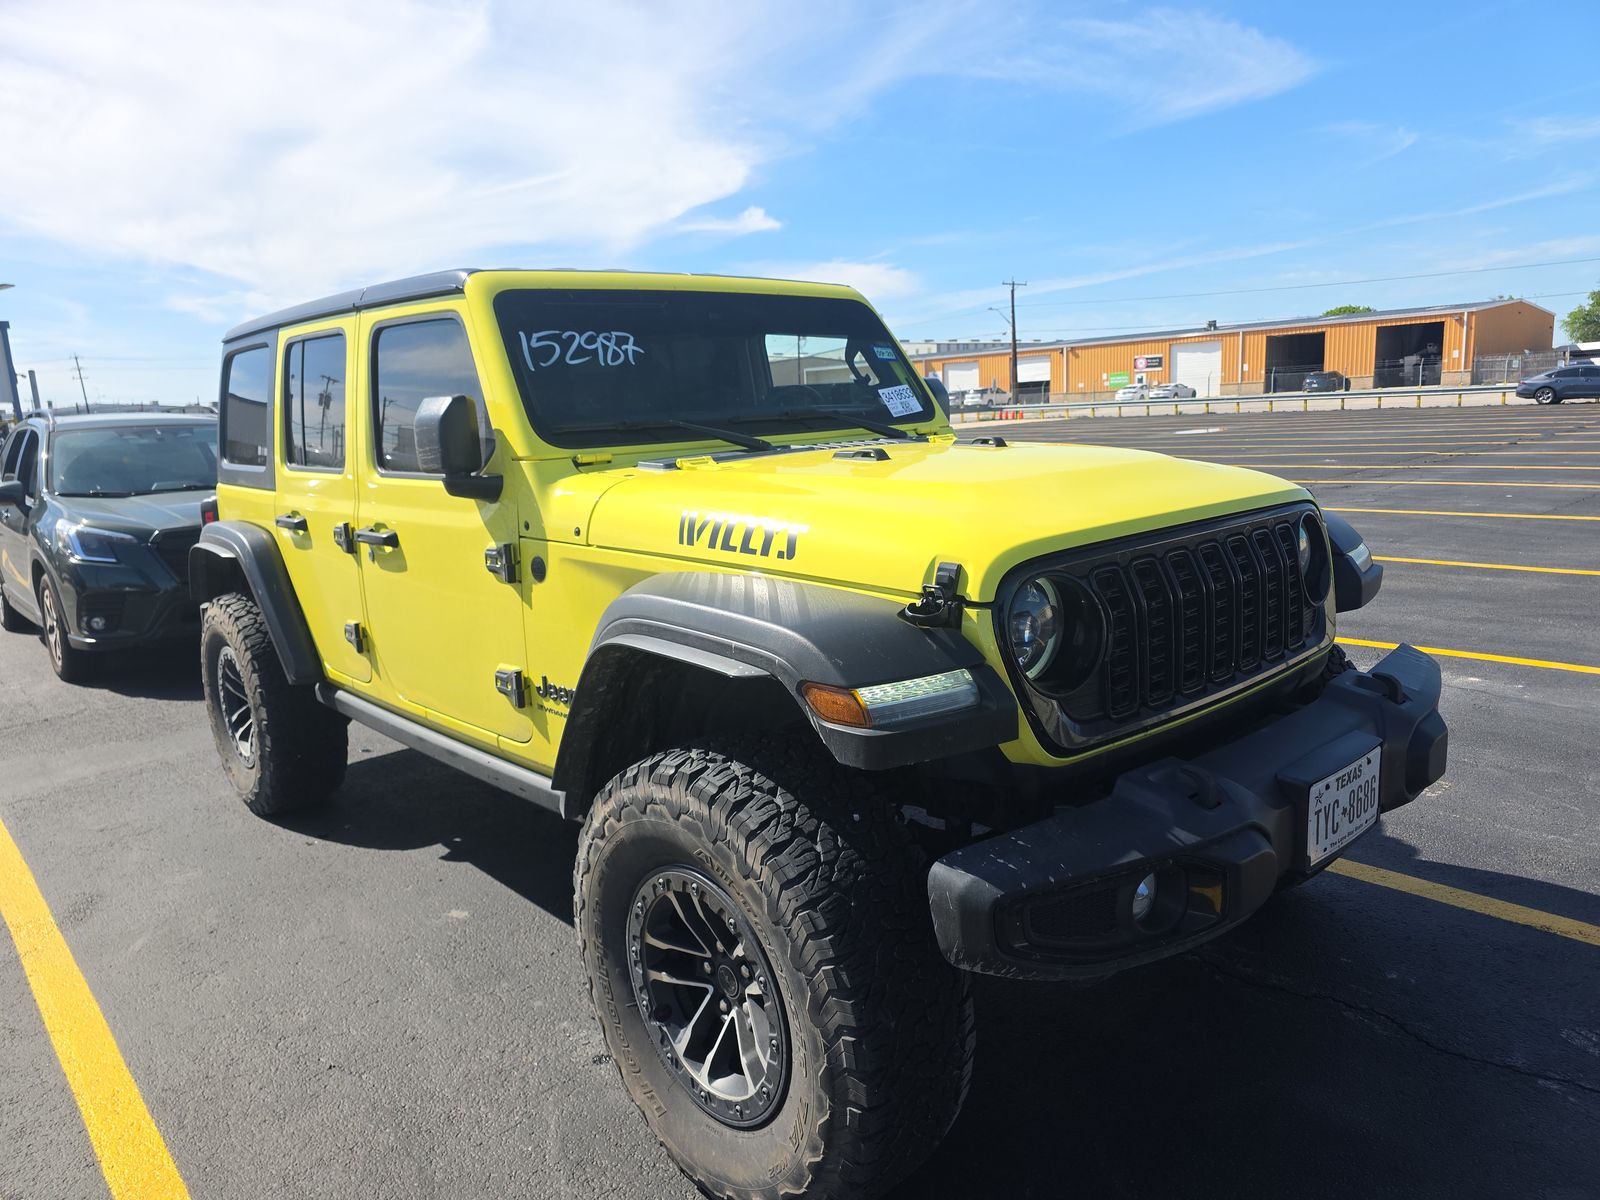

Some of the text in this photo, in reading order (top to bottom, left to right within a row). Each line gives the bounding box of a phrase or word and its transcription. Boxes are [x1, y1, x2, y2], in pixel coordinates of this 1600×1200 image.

[518, 330, 645, 371] 152987
[1335, 764, 1363, 791] TEXAS
[1315, 774, 1376, 845] TYC 8686
